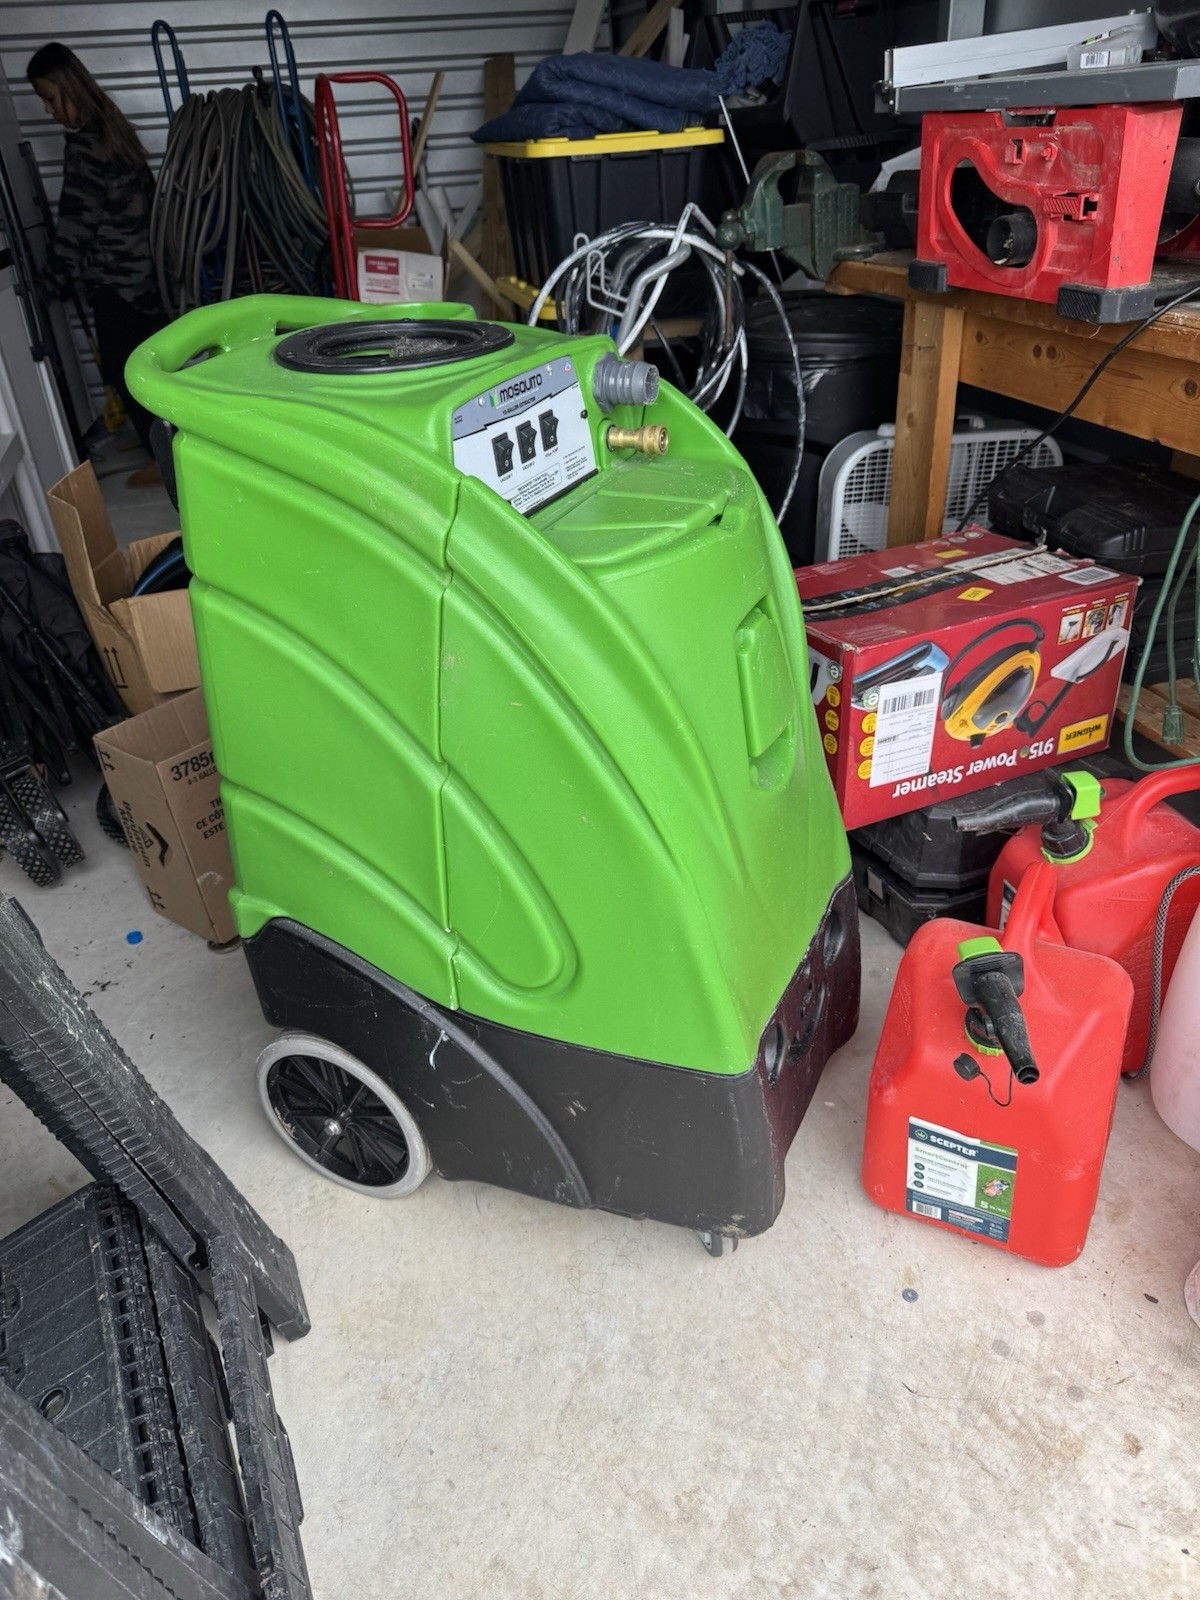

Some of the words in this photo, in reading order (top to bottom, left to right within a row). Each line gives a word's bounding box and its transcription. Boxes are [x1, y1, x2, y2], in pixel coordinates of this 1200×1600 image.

[1064, 723, 1102, 741] WAGNER
[171, 752, 214, 781] 3785
[968, 748, 1018, 776] Power
[892, 766, 963, 798] Steamer
[118, 807, 138, 853] Moore
[122, 800, 150, 868] Benjamin
[196, 817, 208, 830] CE
[203, 822, 225, 839] ESTE
[914, 1146, 968, 1170] SmartControl
[930, 1135, 976, 1157] SCEPTER
[981, 1201, 988, 1209] 5
